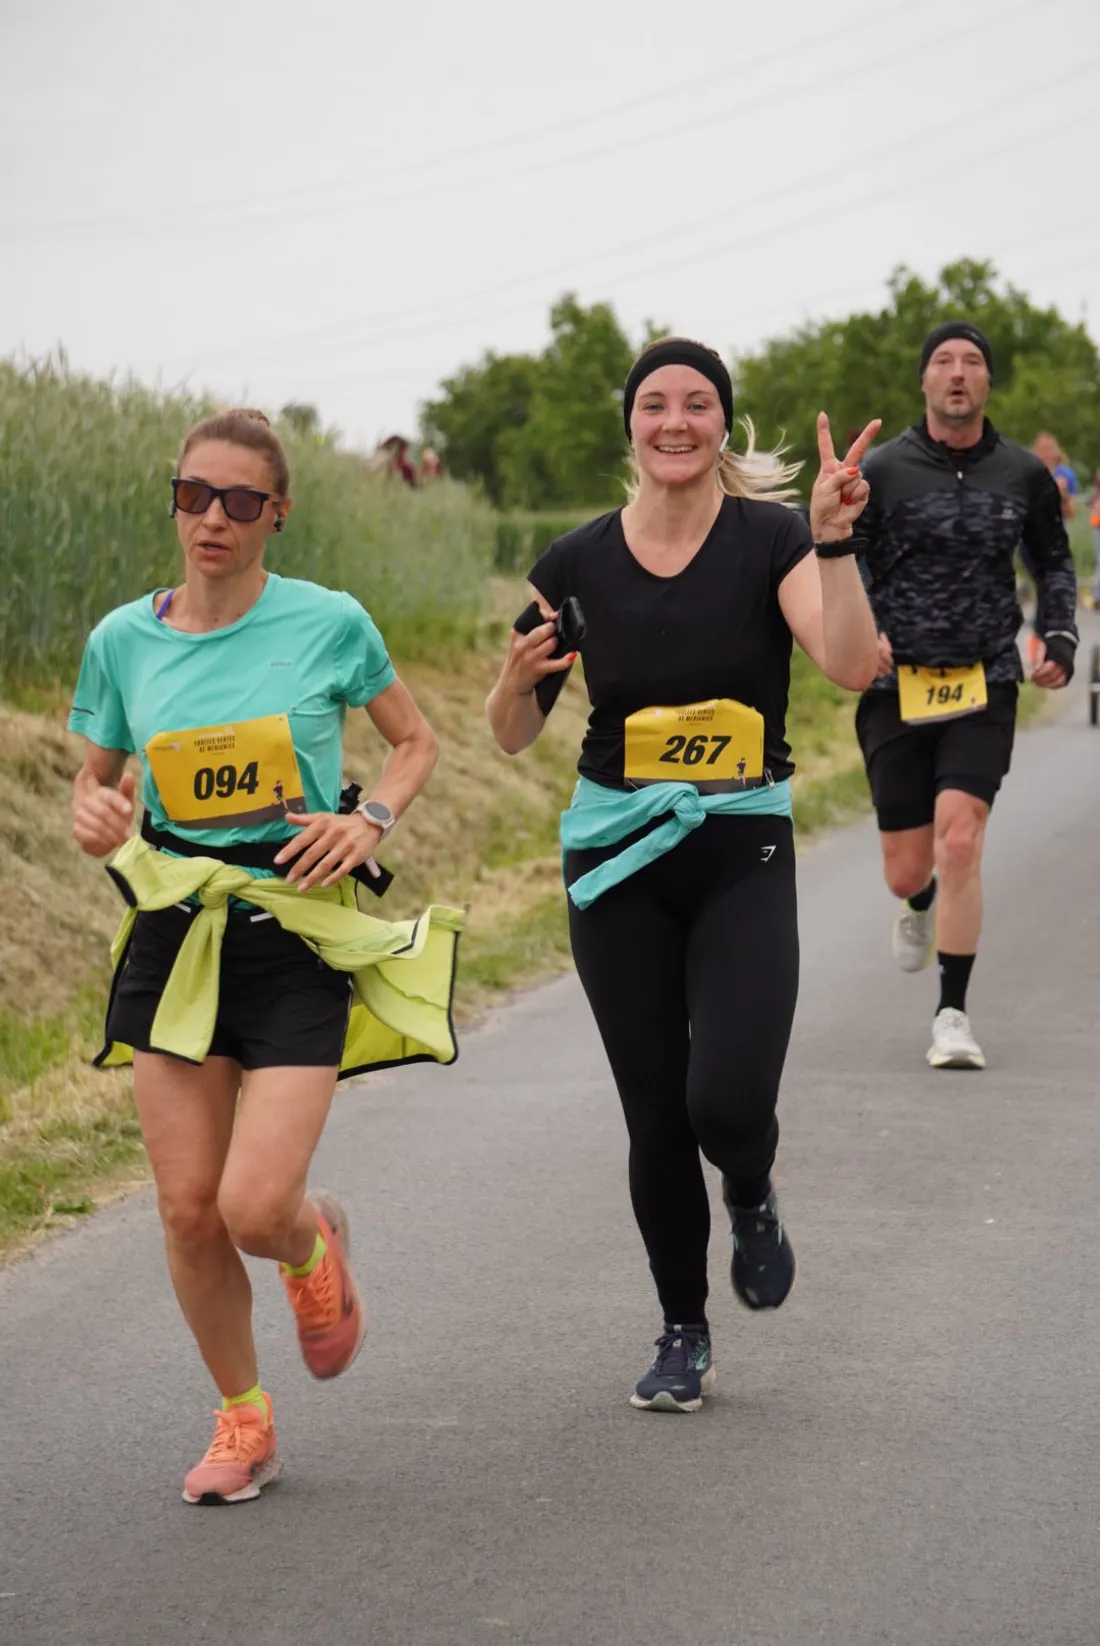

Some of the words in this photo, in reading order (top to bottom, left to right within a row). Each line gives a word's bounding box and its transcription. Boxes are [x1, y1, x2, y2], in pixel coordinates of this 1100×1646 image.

[926, 683, 964, 705] 194
[659, 735, 732, 766] 267
[194, 761, 259, 801] 094
